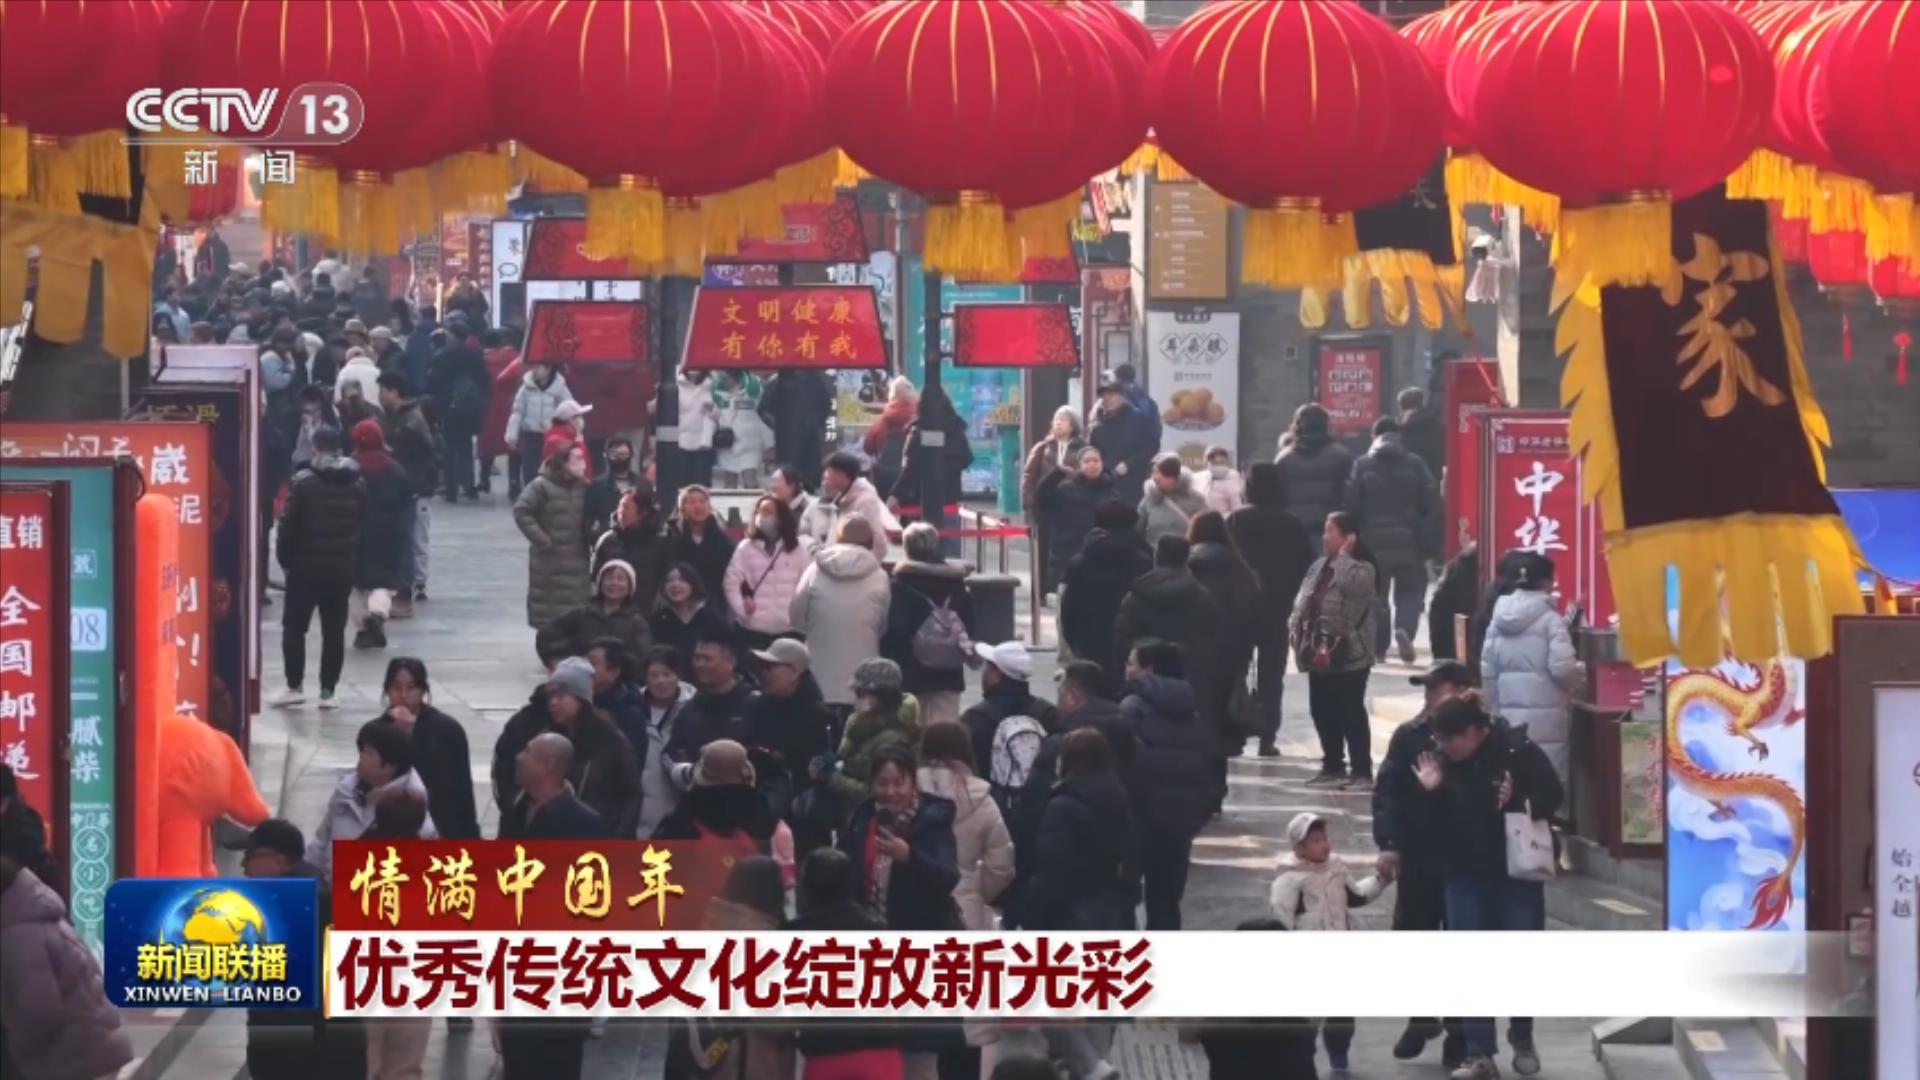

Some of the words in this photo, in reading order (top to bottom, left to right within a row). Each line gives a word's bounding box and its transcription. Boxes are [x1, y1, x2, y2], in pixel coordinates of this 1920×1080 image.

[720, 296, 855, 325] 文明健康
[1661, 232, 1787, 419] 家
[719, 332, 857, 360] 有你有我
